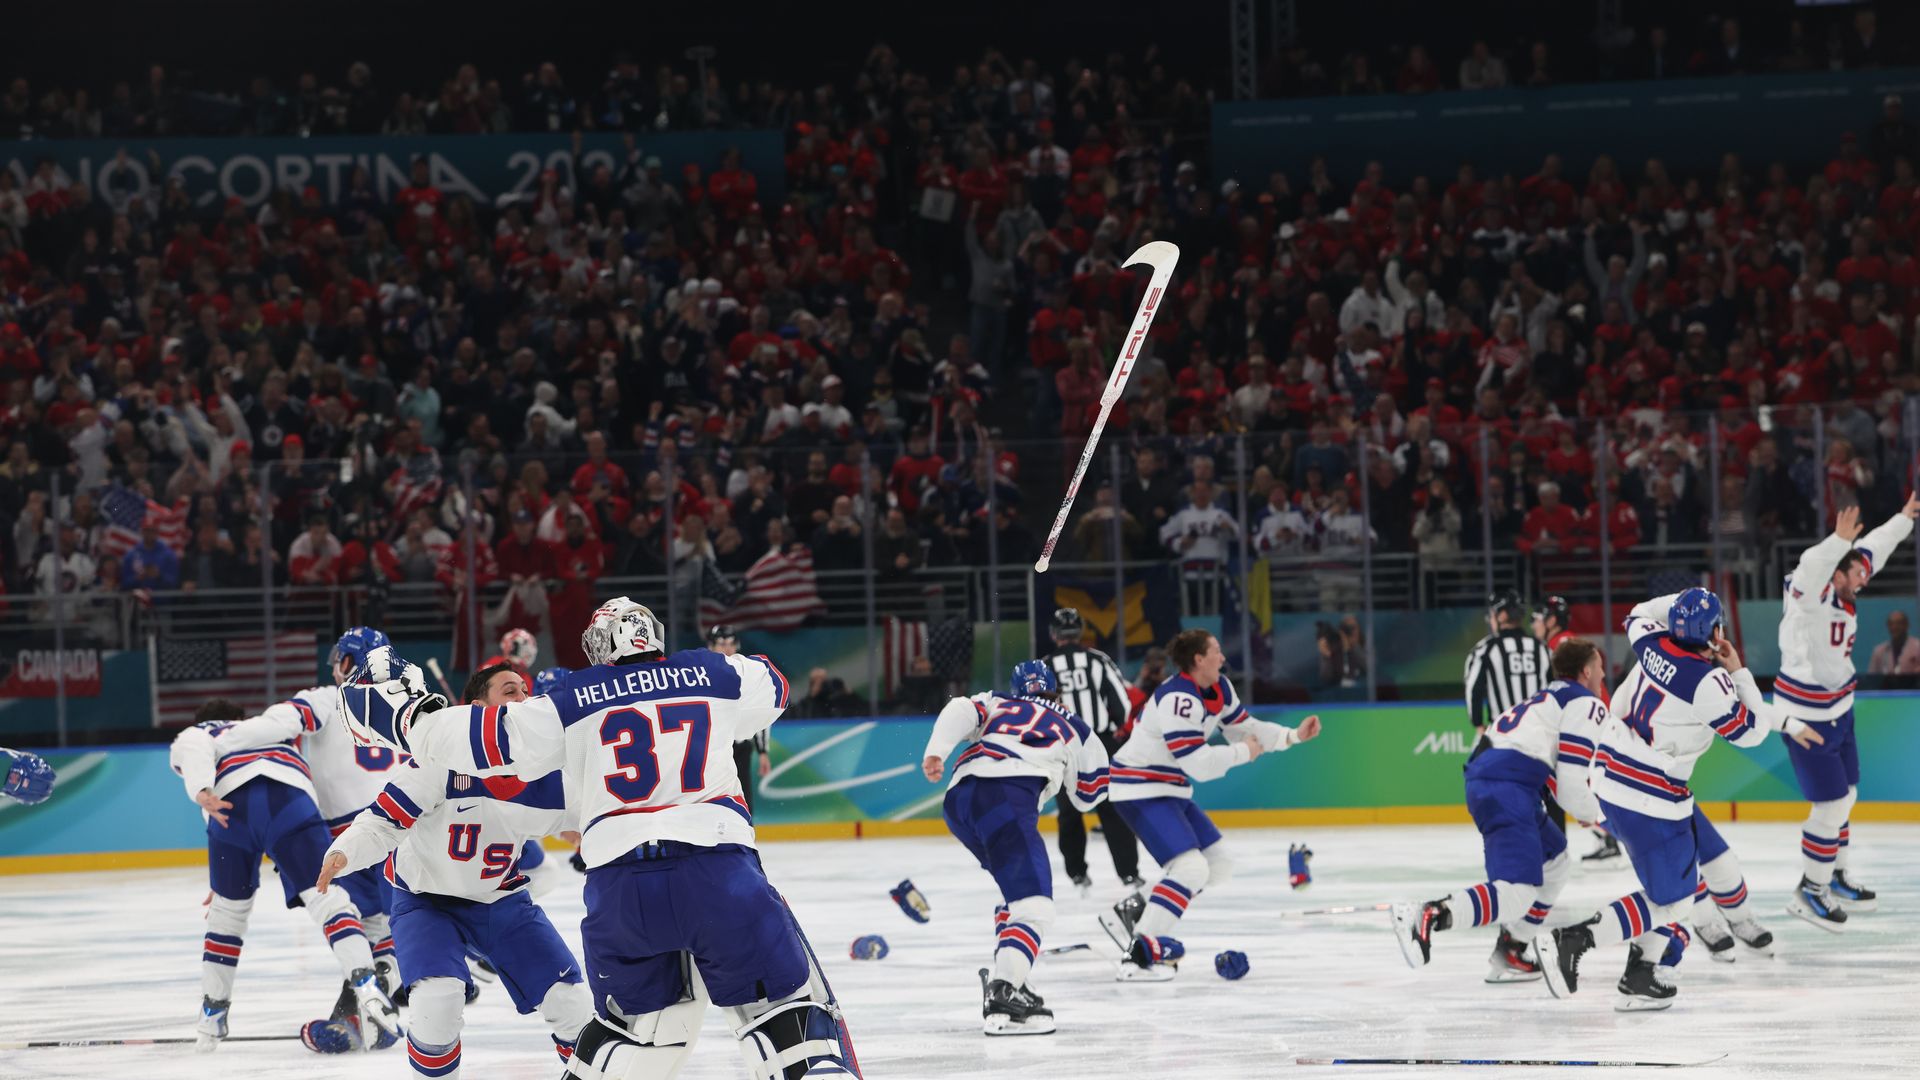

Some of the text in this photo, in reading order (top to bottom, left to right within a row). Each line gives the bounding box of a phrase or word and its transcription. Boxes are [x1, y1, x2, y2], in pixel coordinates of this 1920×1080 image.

[168, 152, 490, 207] CORTINA
[1113, 287, 1162, 388] TRUE
[17, 648, 98, 682] CANADA
[1058, 667, 1089, 693] 50
[1508, 652, 1536, 674] 66
[1642, 646, 1677, 686] FABER
[574, 666, 712, 707] HELLEBUYCK
[1712, 672, 1735, 696] 14
[982, 699, 1075, 749] 25
[1173, 695, 1194, 719] 12
[1587, 700, 1606, 726] 19
[599, 700, 713, 805] 37
